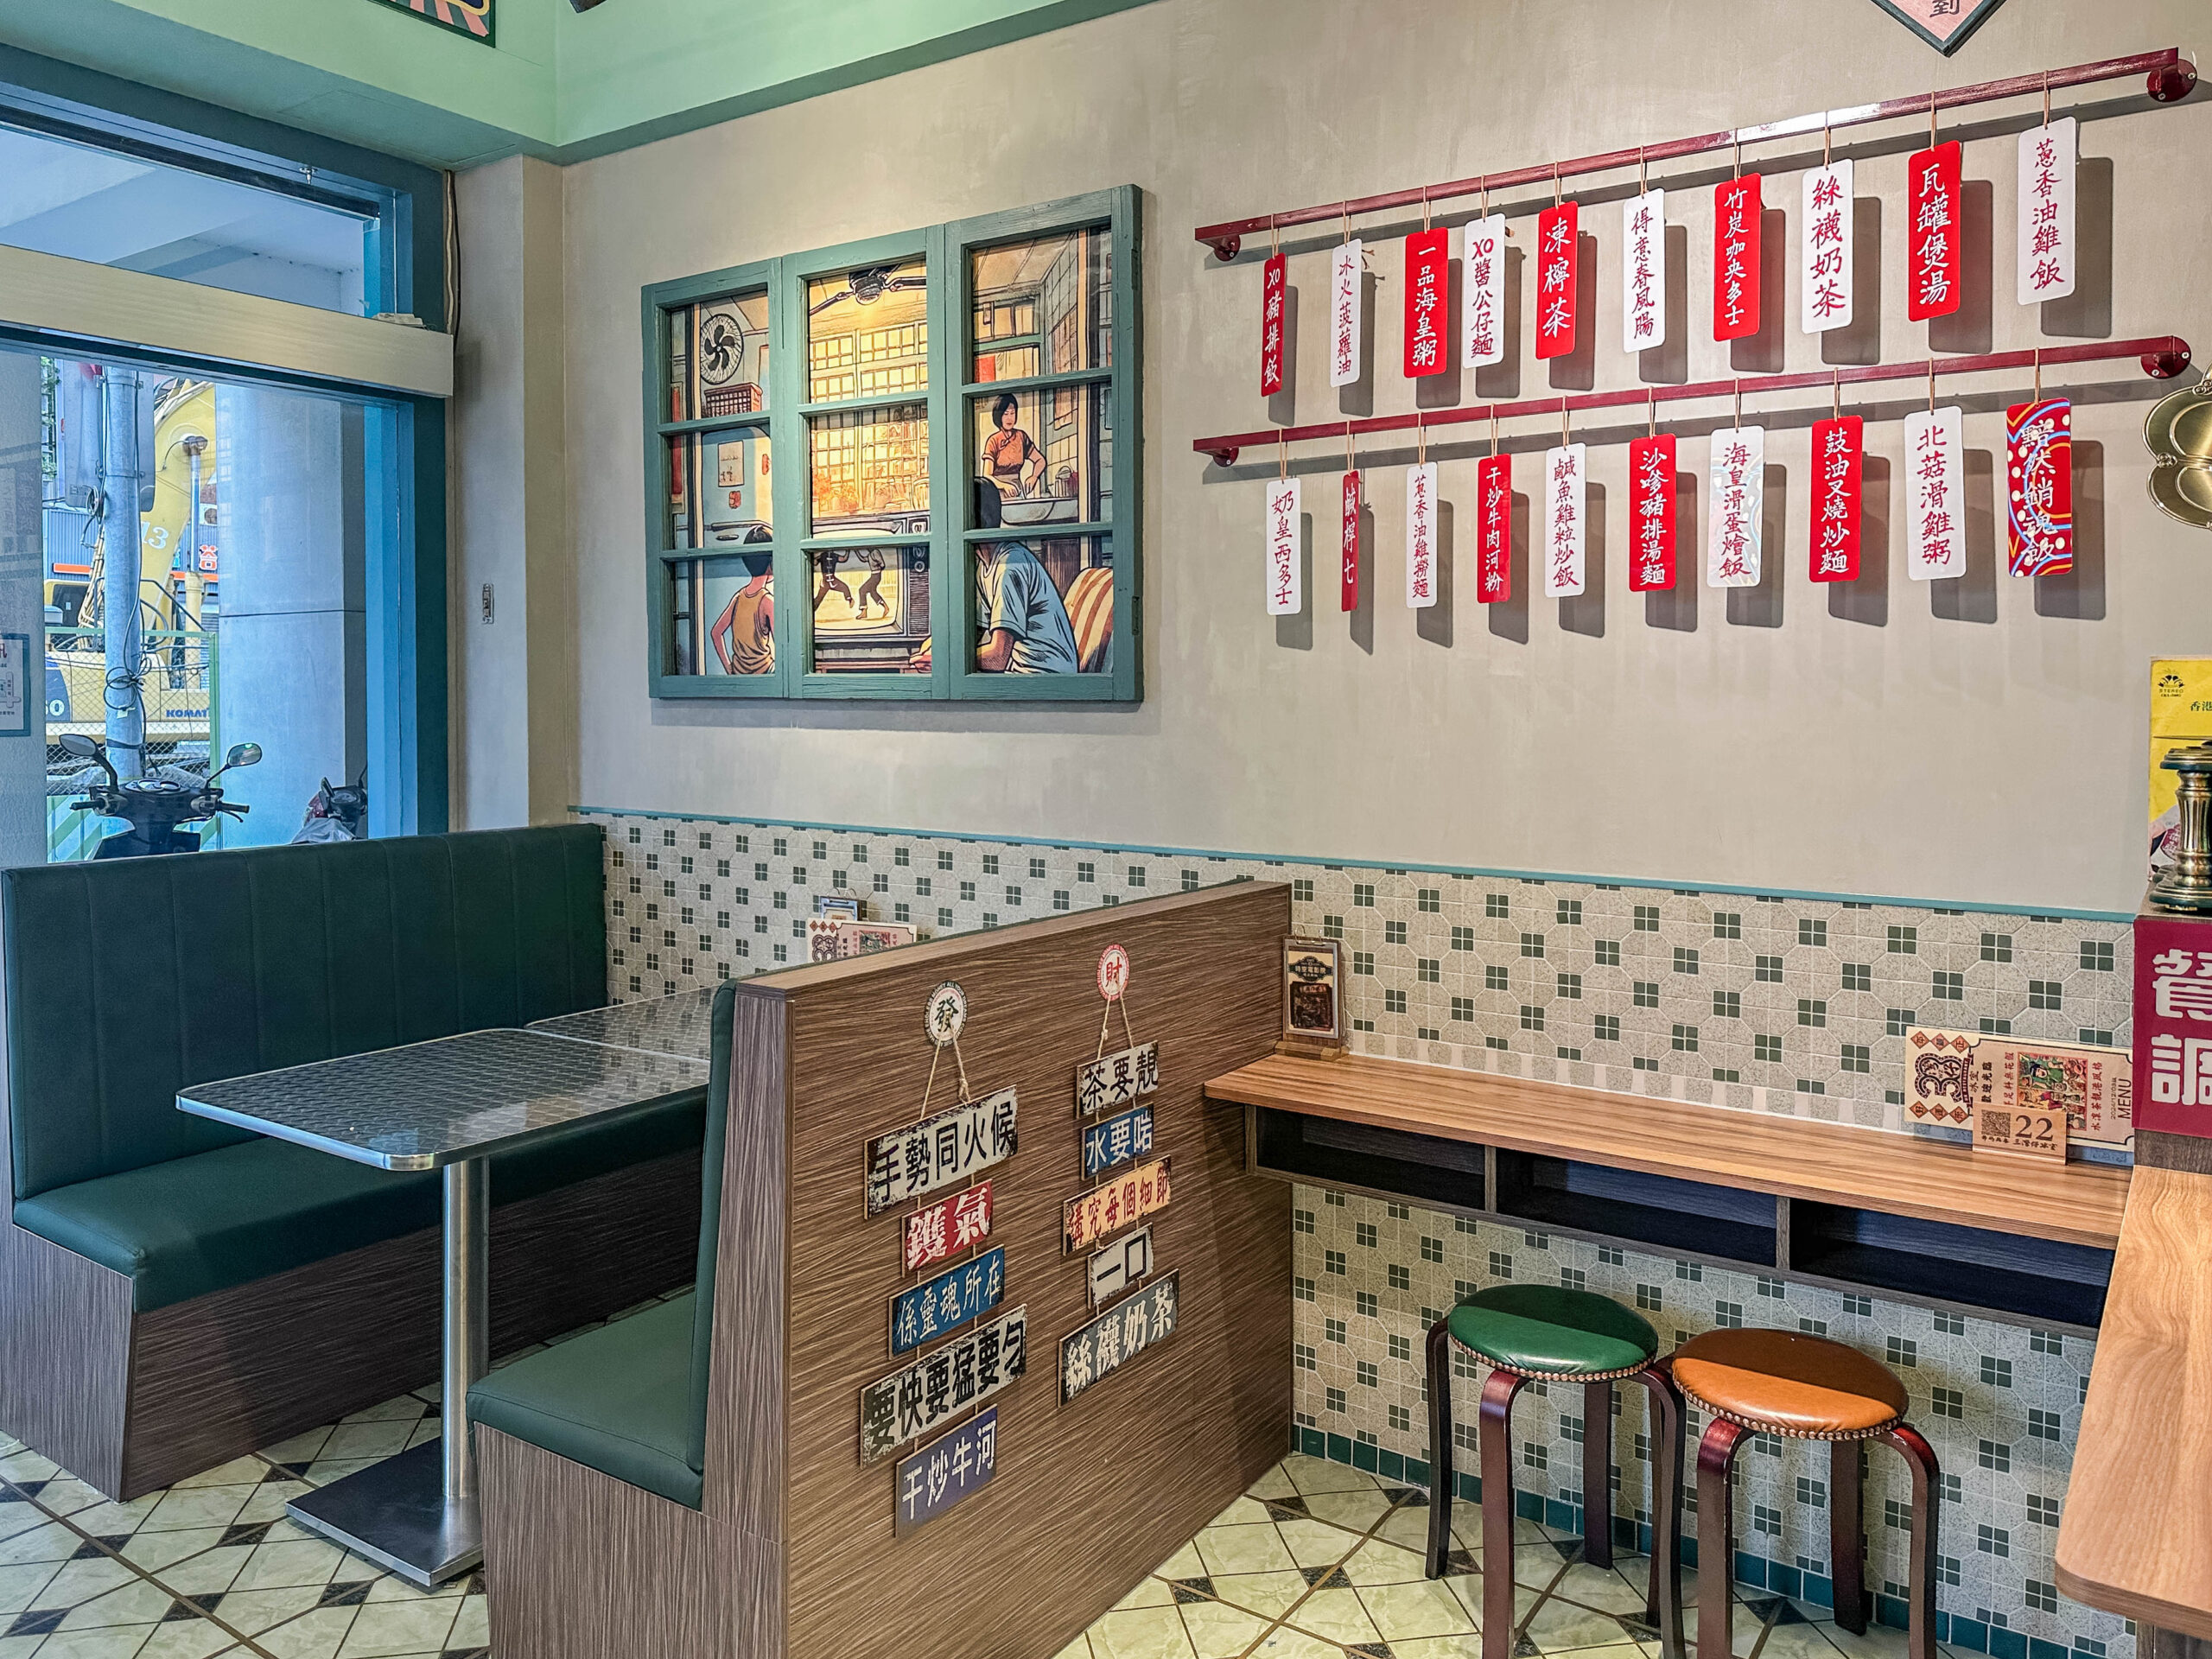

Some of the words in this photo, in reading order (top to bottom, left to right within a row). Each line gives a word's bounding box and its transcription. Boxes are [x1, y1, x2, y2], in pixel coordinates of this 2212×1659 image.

[1542, 217, 1572, 338] 凍檸茶
[1631, 207, 1655, 339] 得意春風腸
[1724, 188, 1749, 326] 竹炭咖央多士
[1809, 175, 1846, 319] 絲襪奶茶
[1916, 162, 1951, 305] 瓦罐煲湯
[1338, 255, 1355, 376] 冰火菠蘿油
[1413, 246, 1438, 366] 一品海皇粥
[1471, 238, 1495, 358] XO醬公仔麵
[1272, 490, 1294, 605] 奶皇西多士
[1484, 467, 1503, 593] 干炒牛肉河粉
[1553, 454, 1580, 588] 鹹魚雞粒炒飯
[1639, 448, 1669, 586] 沙嗲豬排湯麵
[1719, 442, 1751, 578] 海皇滑蛋燴飯
[1916, 425, 1955, 565] 北菇滑雞粥
[2020, 419, 2058, 567] 黯然銷魂飯
[45, 698, 65, 716] 0
[935, 996, 959, 1033] 發
[1105, 957, 1122, 988] 財
[1083, 1050, 1158, 1109] 茶要靚
[2015, 1115, 2053, 1141] 22
[2118, 1078, 2132, 1120] MENU
[874, 1101, 1014, 1202] 手勢同火候
[1086, 1110, 1153, 1173] 水要啱
[906, 1187, 989, 1270] 鑊氣
[1070, 1166, 1167, 1246] 講究每個細節
[1097, 1232, 1147, 1284] 一口
[897, 1255, 1001, 1345] 係靈魂所在
[1065, 1281, 1174, 1397] 絲襪奶茶
[902, 1420, 995, 1520] 干炒牛河
